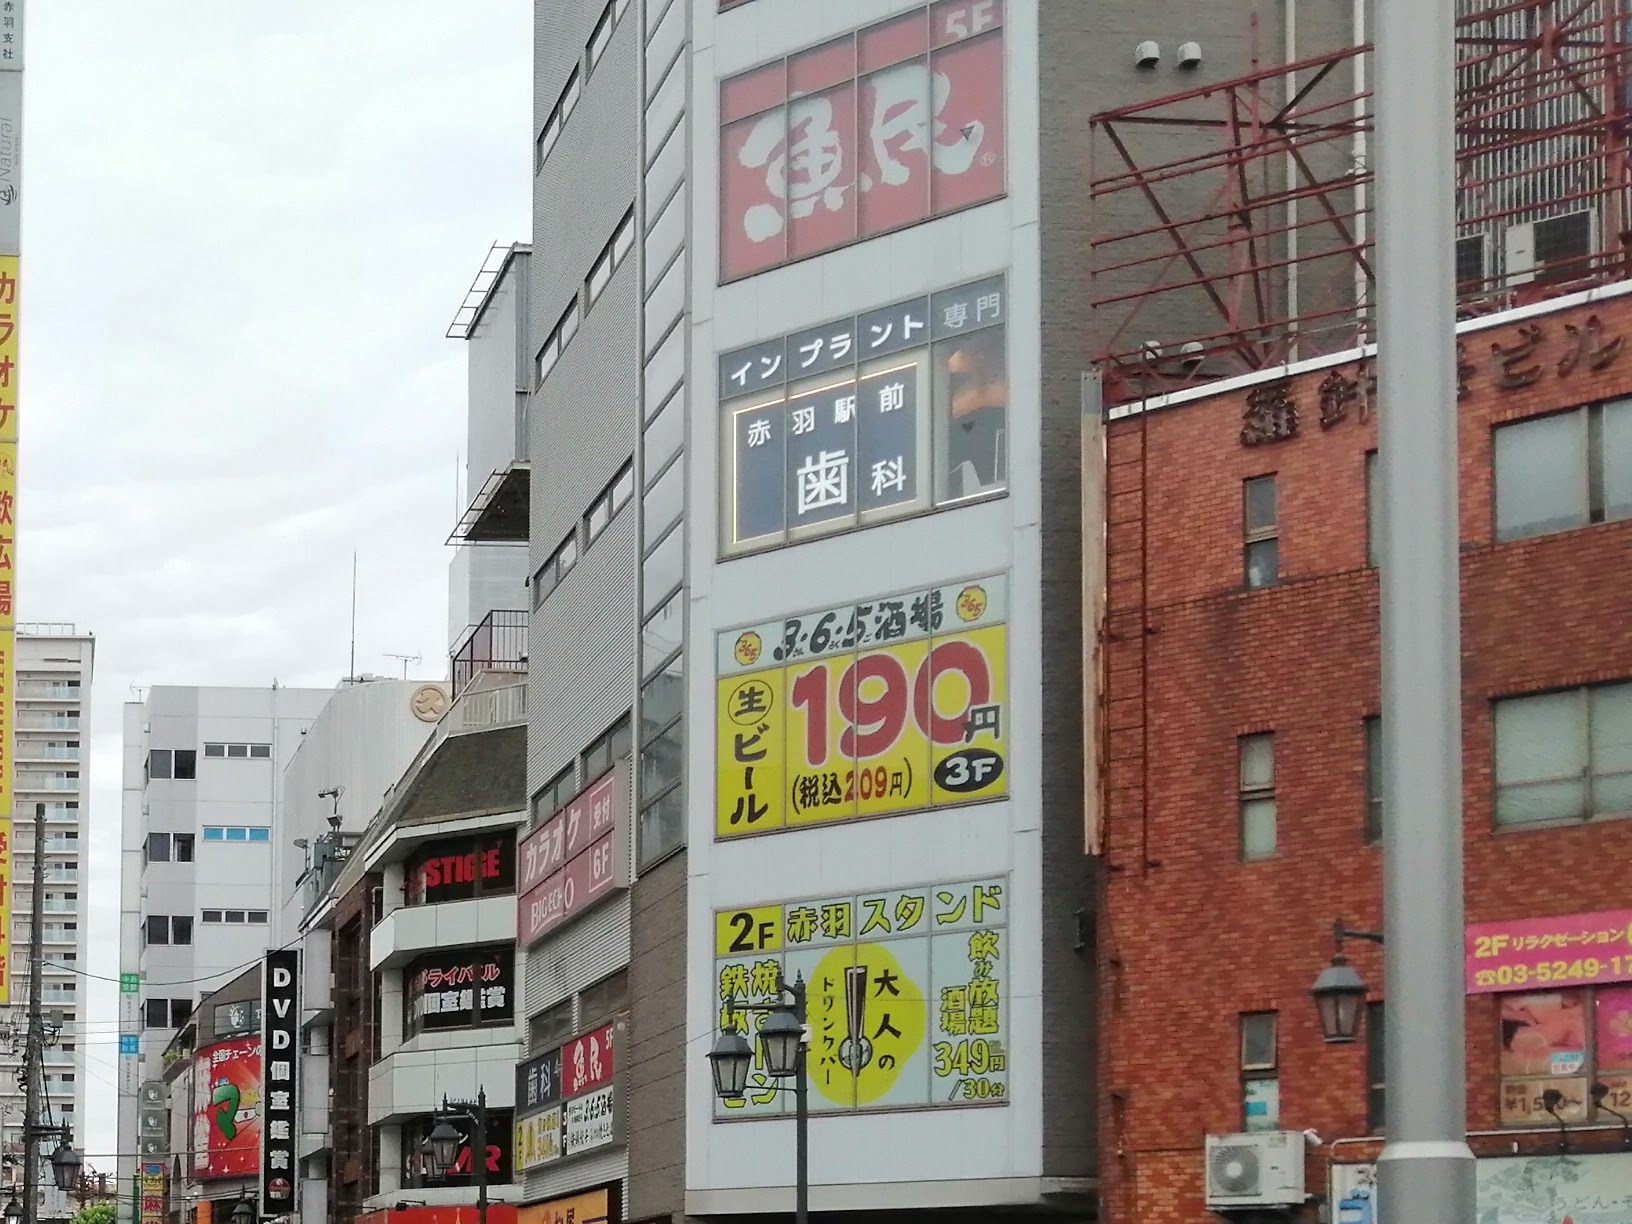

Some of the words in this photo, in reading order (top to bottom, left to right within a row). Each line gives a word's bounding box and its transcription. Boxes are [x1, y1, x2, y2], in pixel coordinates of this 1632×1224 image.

[2, 1, 15, 60] 赤羽支社
[946, 9, 994, 40] 5F
[747, 381, 904, 447] 赤羽駅前
[796, 450, 906, 515] 歯科
[793, 642, 1001, 767] 190円
[730, 686, 769, 825] 生ビール
[945, 755, 996, 786] 3F
[425, 848, 500, 888] STIGE
[525, 808, 581, 884] カラオケ
[593, 841, 609, 880] 6F
[729, 912, 774, 953] 2F
[788, 885, 1002, 943] 赤羽スタンド
[1475, 934, 1509, 958] 2F
[1513, 929, 1625, 951] リラクゼーション
[940, 986, 967, 1036] 酒場
[968, 930, 999, 1035] 飲み放題
[820, 977, 836, 1085] ドリンクバー
[874, 969, 901, 1070] 大人の
[934, 1039, 1005, 1077] 349円
